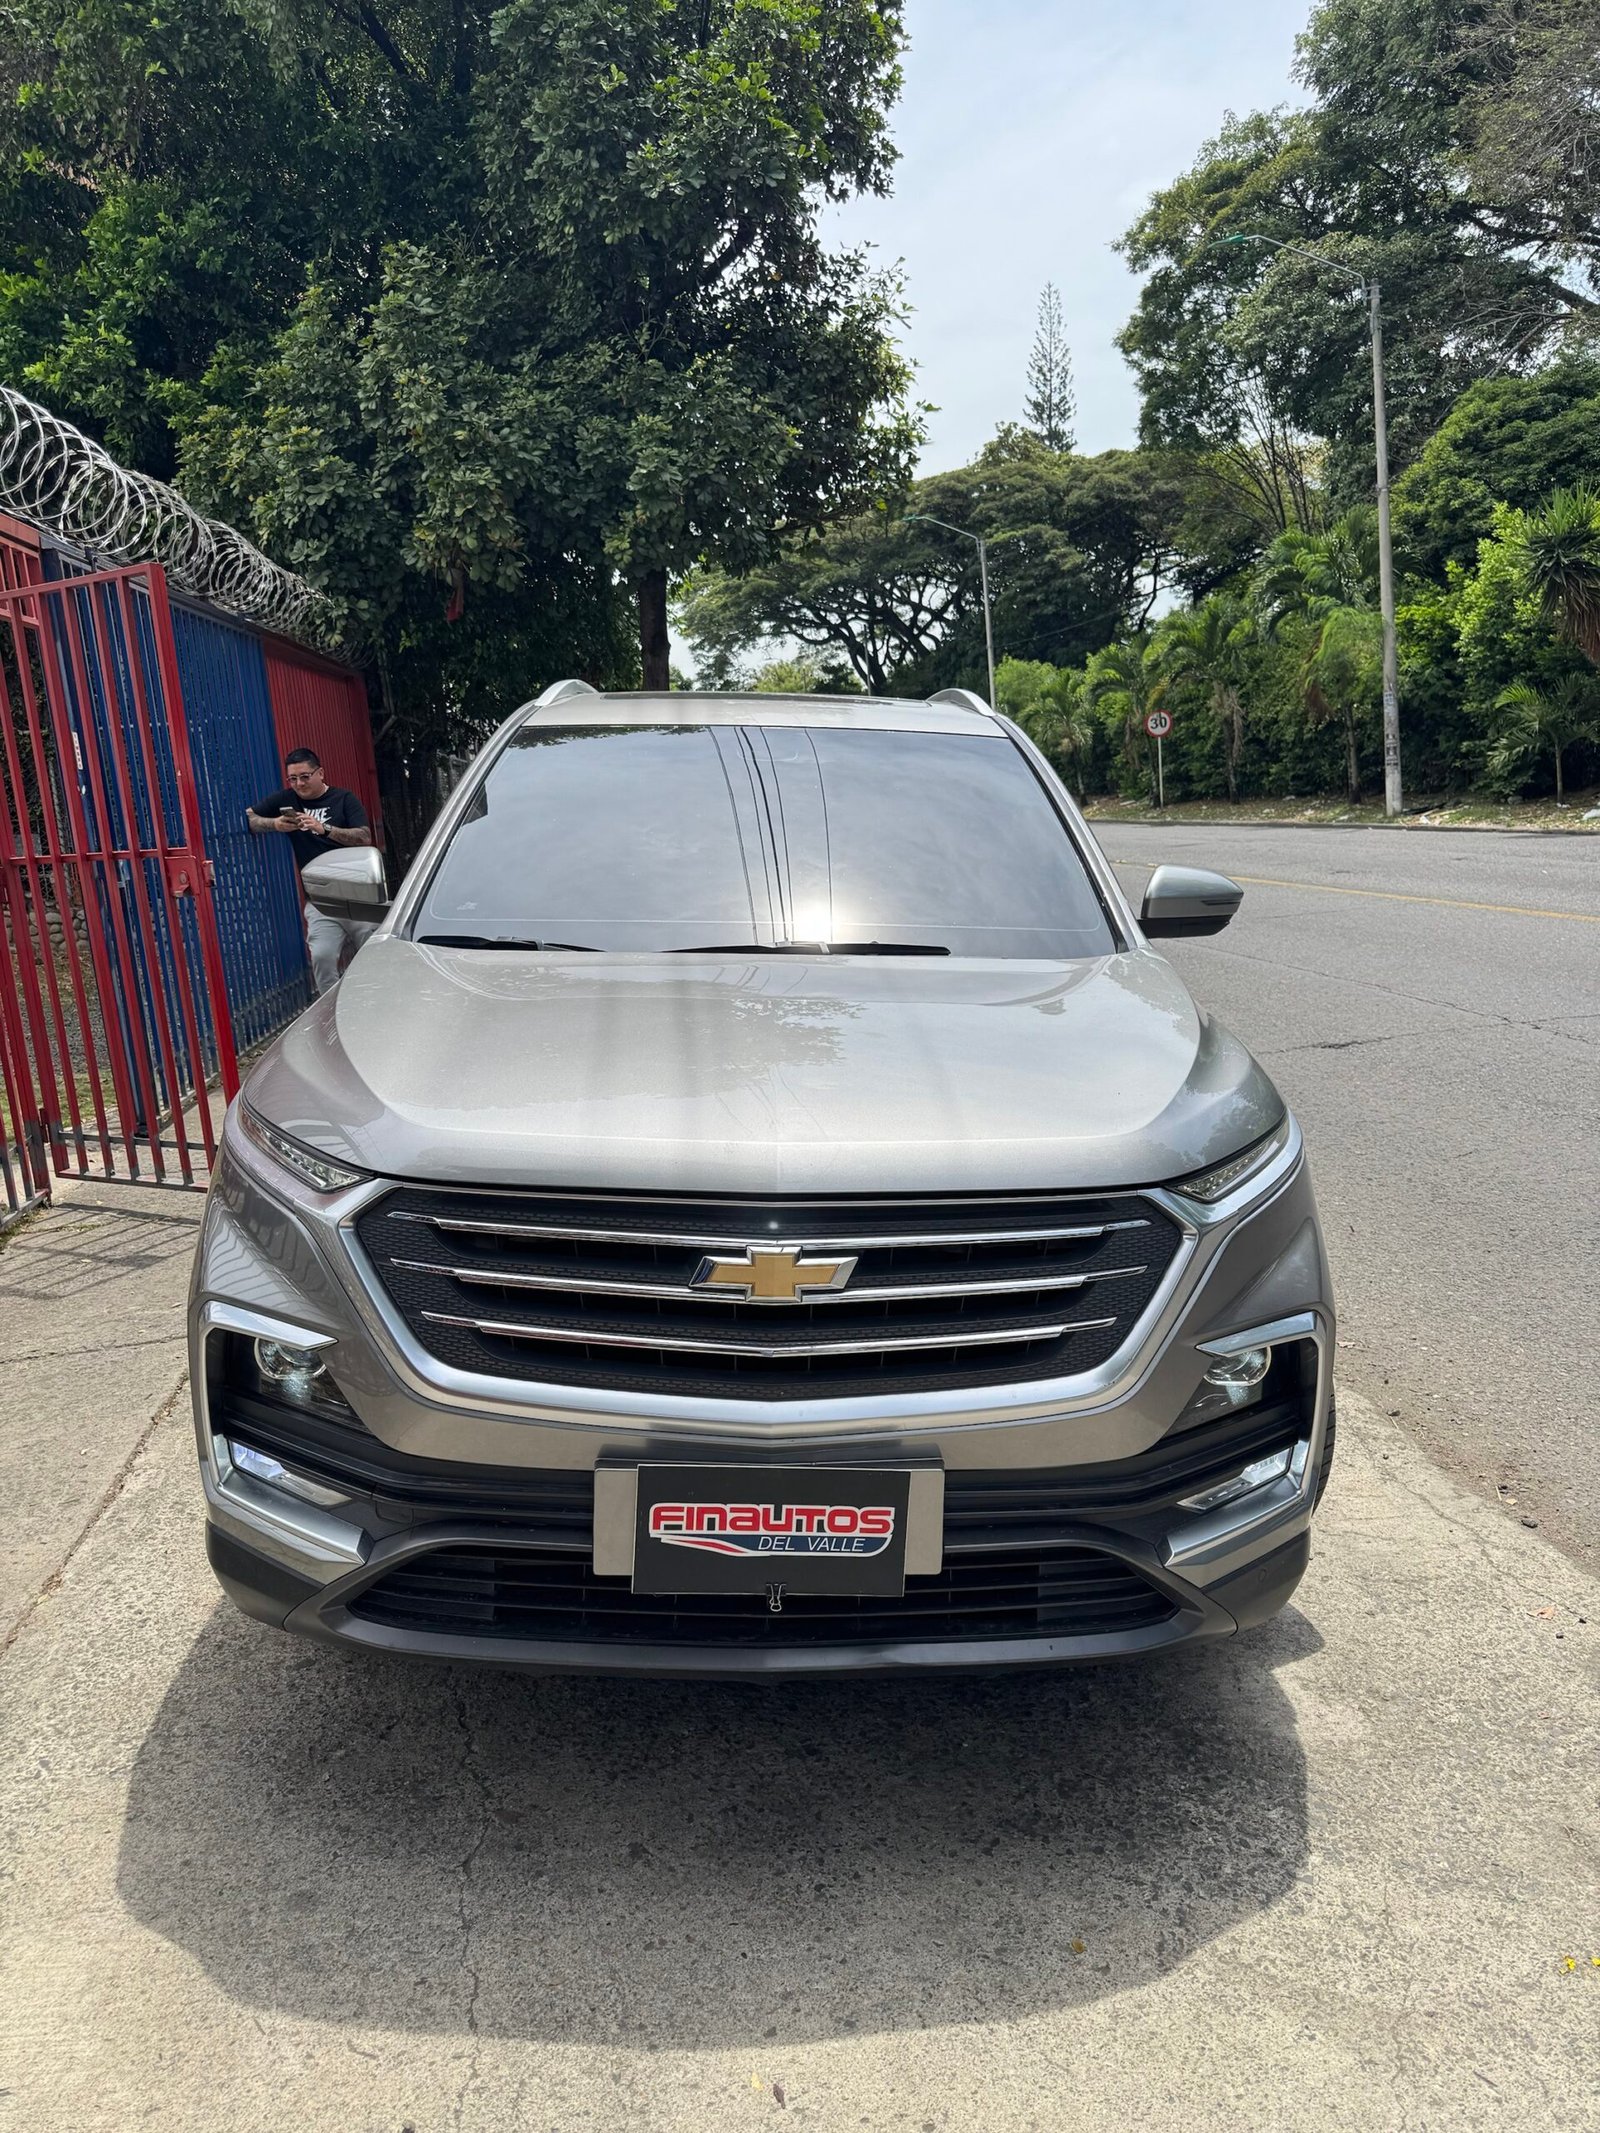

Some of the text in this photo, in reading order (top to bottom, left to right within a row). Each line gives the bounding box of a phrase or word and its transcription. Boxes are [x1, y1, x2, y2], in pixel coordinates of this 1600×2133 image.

[1150, 717, 1167, 729] 30
[757, 1536, 866, 1552] DEL VALLE
